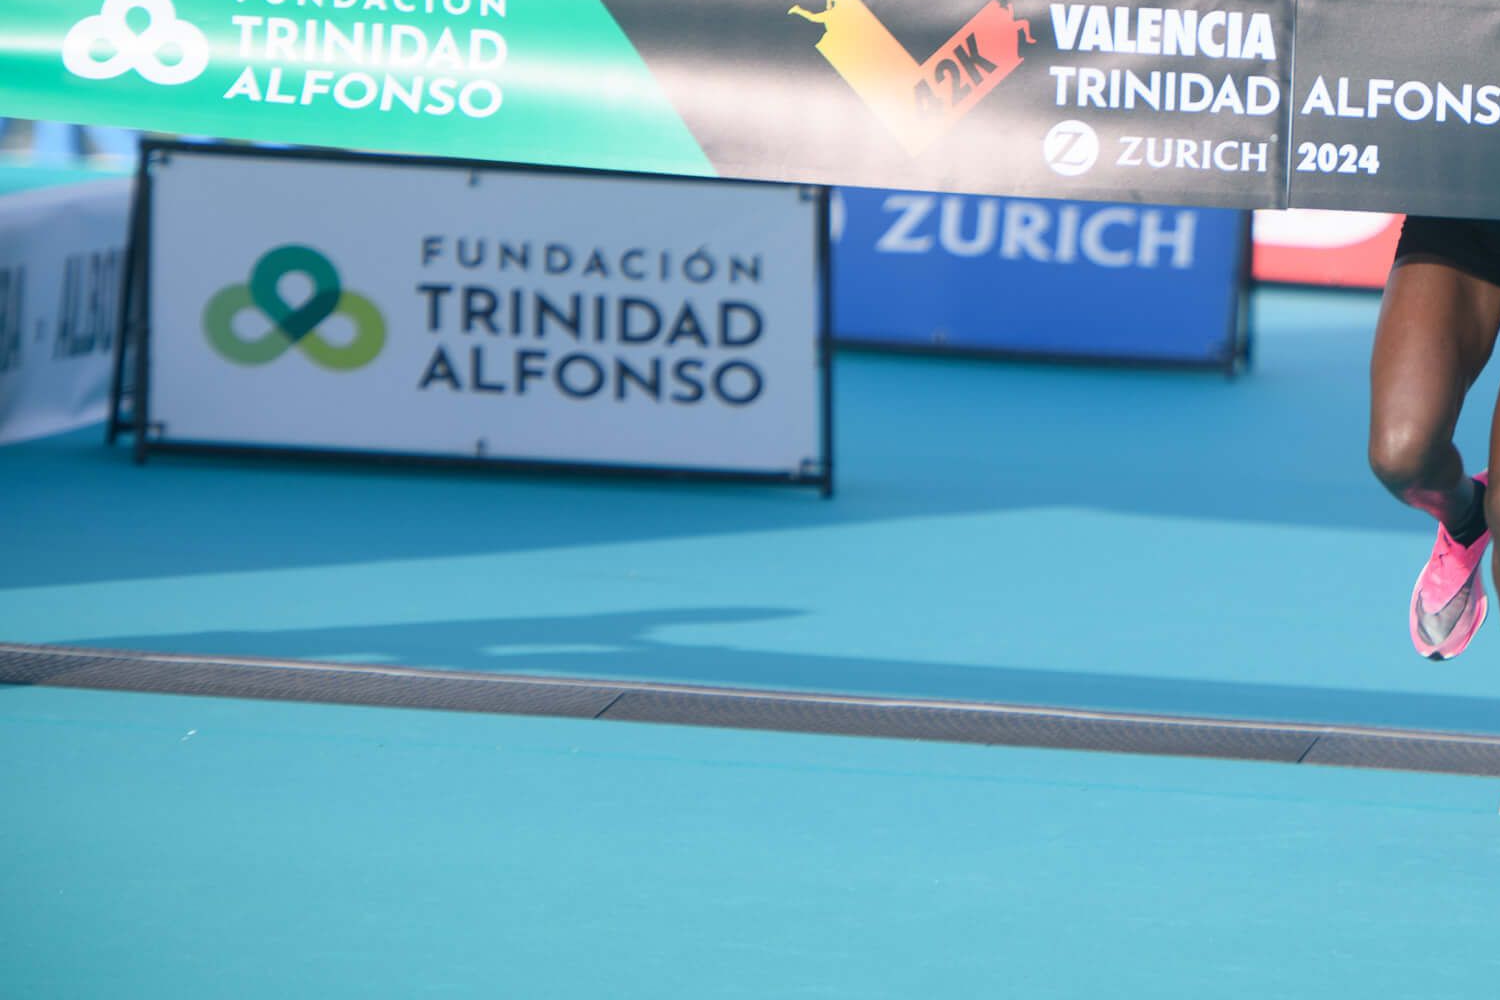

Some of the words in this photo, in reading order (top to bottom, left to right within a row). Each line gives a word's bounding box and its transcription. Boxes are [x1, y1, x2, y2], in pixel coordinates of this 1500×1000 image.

[231, 14, 508, 71] TRINIDAD
[1050, 3, 1277, 61] VALENCIA
[222, 66, 503, 119] ALFONSO
[1049, 65, 1281, 116] TRINIDAD
[1116, 136, 1268, 172] ZURICH
[1296, 141, 1380, 175] 2024
[421, 234, 764, 285] FUNDACIÓN
[874, 195, 1197, 269] ZURICH
[415, 283, 766, 349] TRINIDAD
[416, 343, 766, 408] ALFONSO
